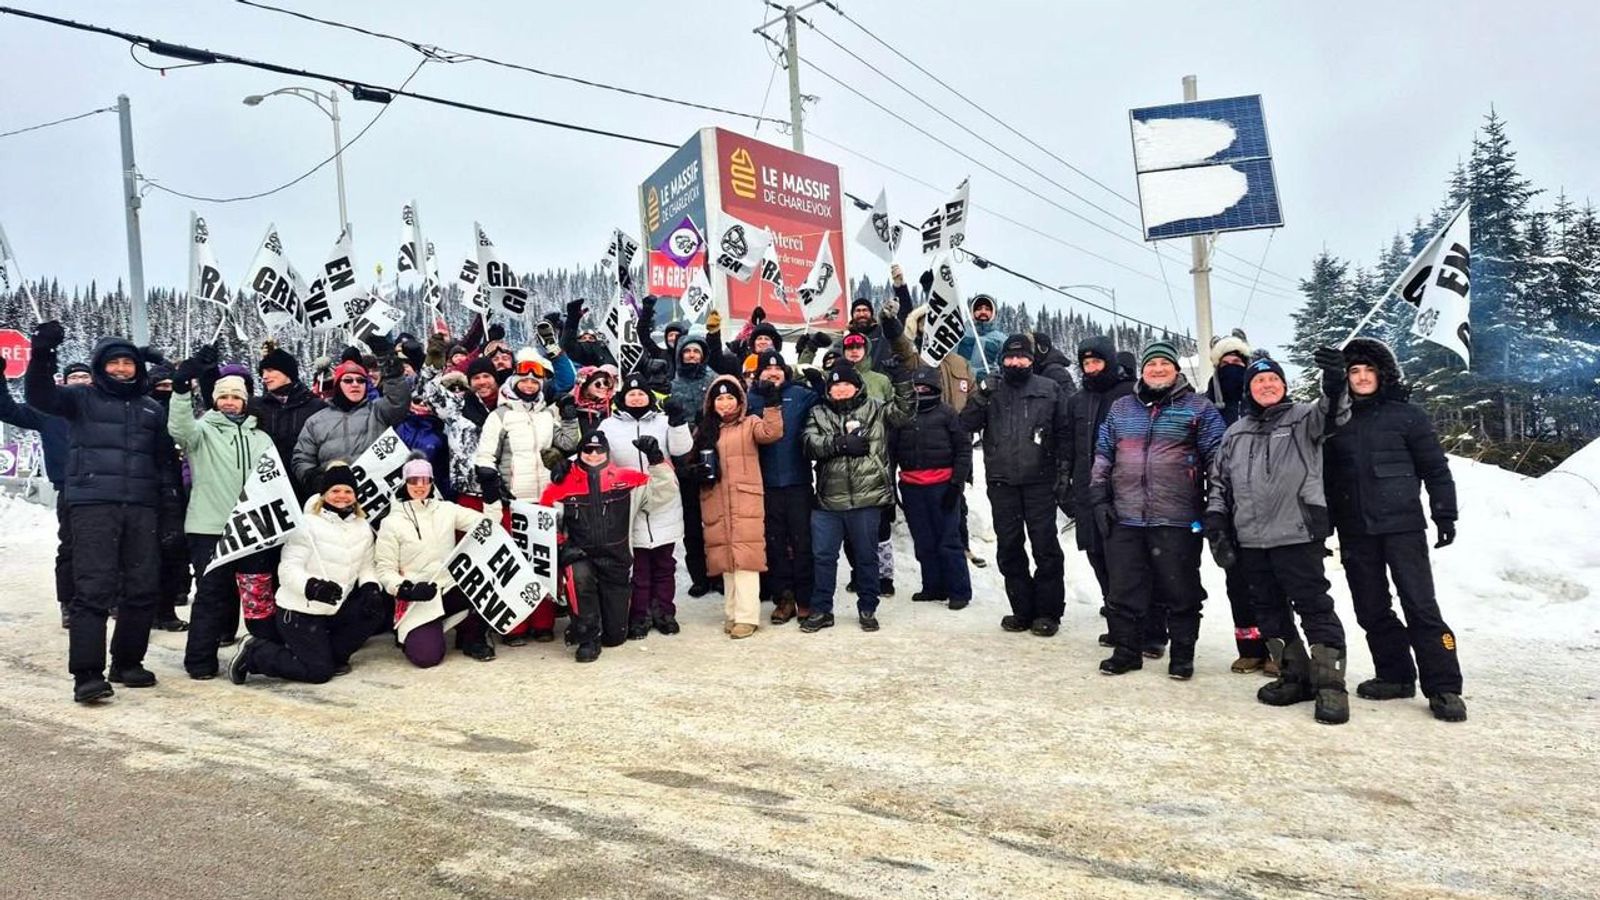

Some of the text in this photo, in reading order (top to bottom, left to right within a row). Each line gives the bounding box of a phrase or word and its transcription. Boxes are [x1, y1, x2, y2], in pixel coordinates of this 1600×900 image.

[661, 160, 699, 206] LE MASSIF
[762, 166, 831, 202] LE MASSIF
[763, 189, 832, 218] DE CHARLEVOIX
[945, 199, 964, 227] EN
[772, 231, 804, 252] Merci
[325, 255, 356, 292] EN
[459, 258, 480, 285] EN
[652, 264, 664, 287] EN
[693, 293, 709, 313] CSN
[0, 344, 32, 361] RÊT
[260, 469, 281, 483] CSN
[486, 543, 521, 589] EN
[532, 542, 552, 579] EN
[447, 552, 518, 634] GRÈVE
